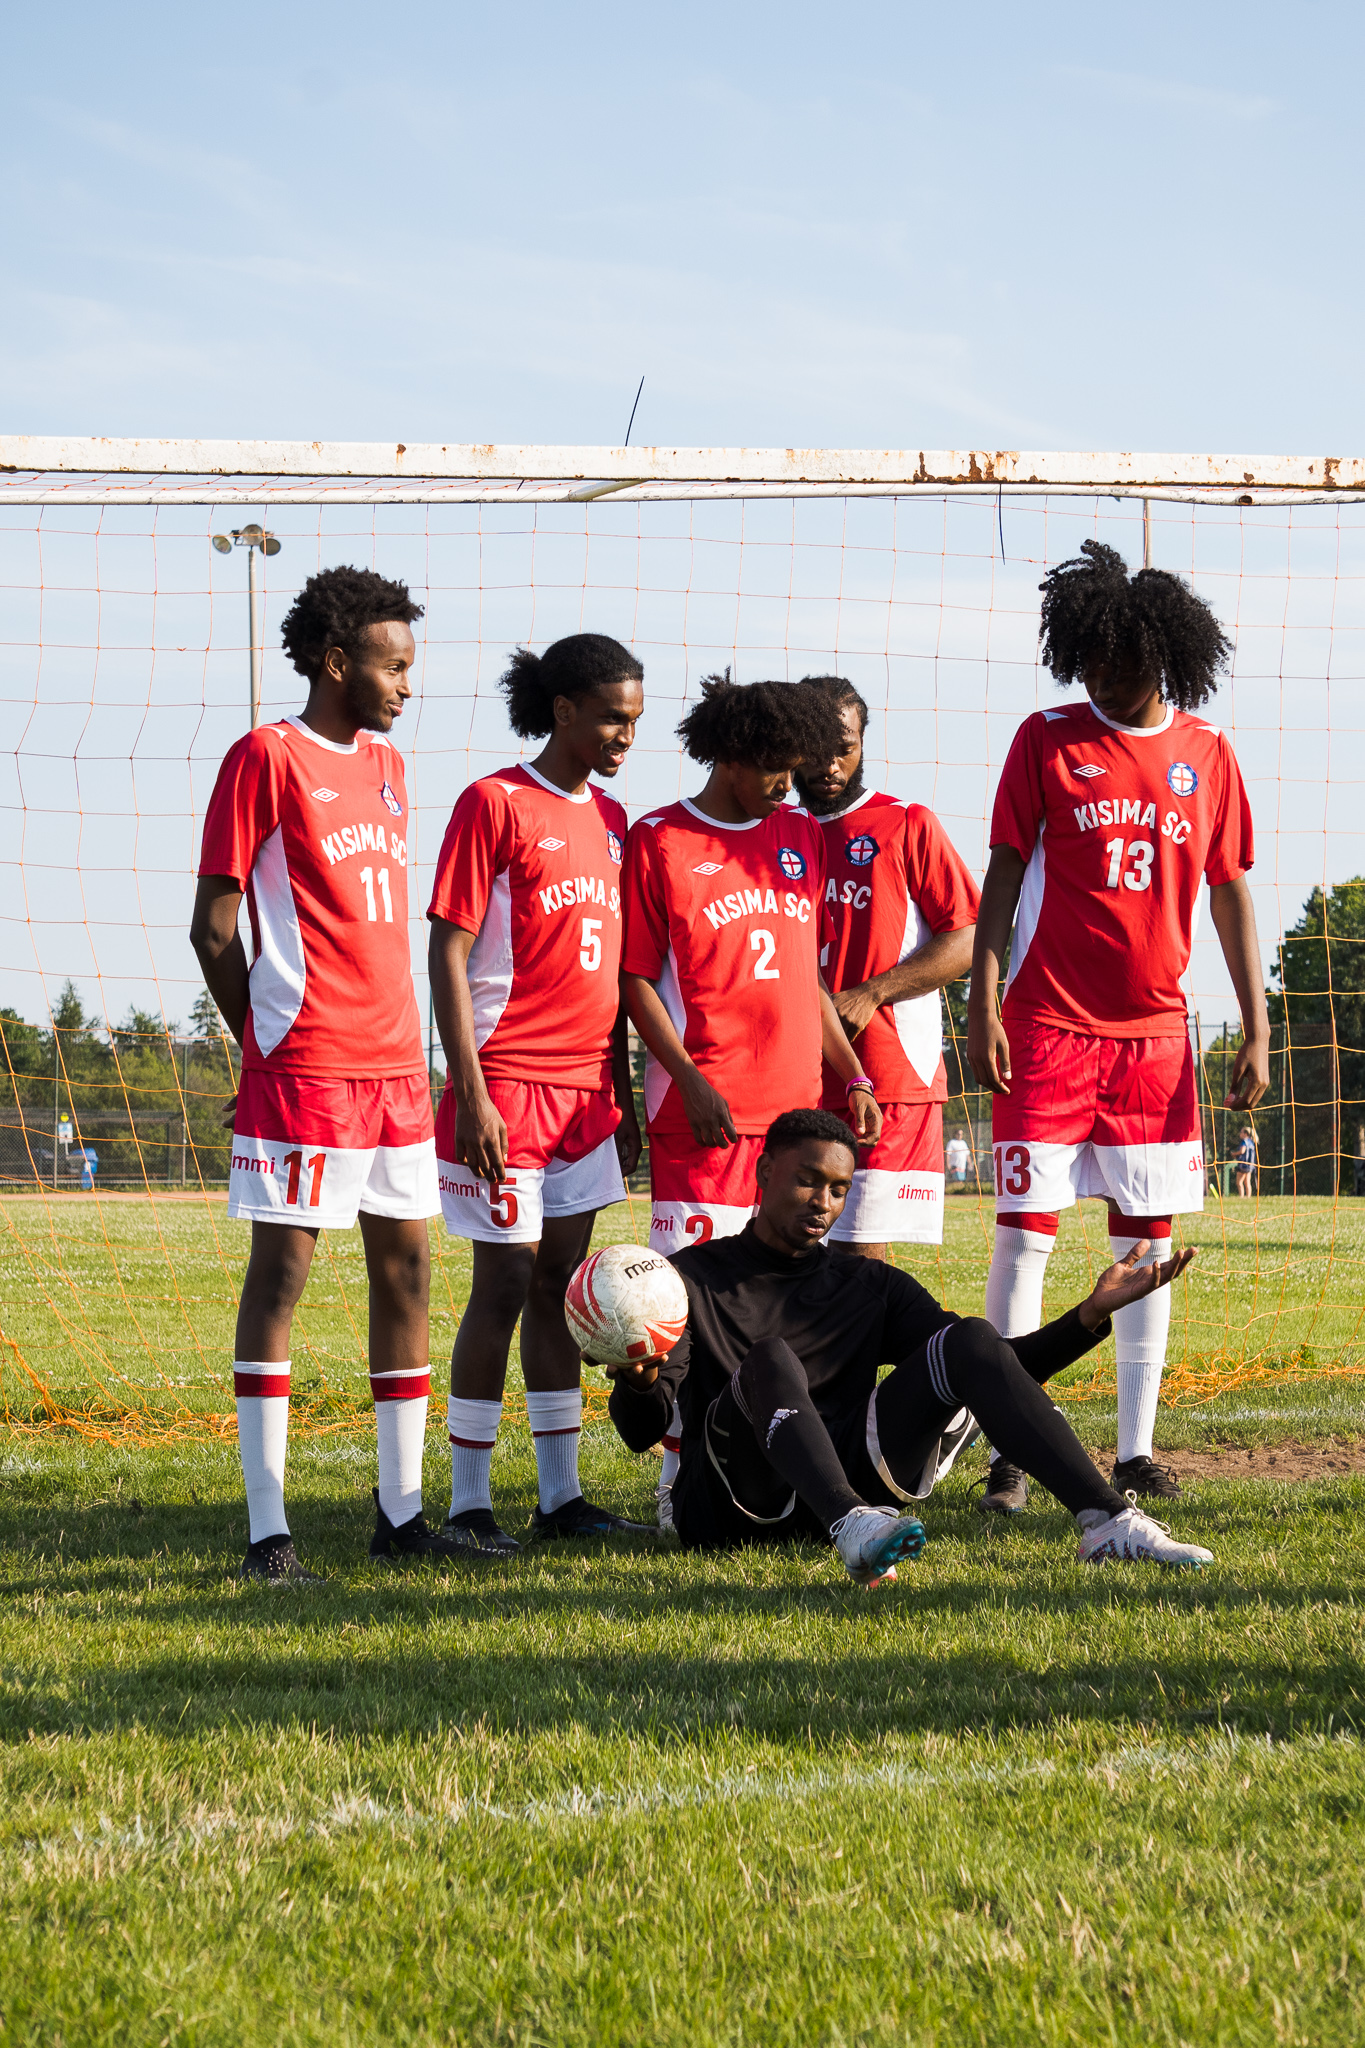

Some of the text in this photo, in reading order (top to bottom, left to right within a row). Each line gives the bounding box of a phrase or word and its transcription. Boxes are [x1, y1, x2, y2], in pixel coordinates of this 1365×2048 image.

[320, 823, 407, 867] KISIMA SC
[1073, 798, 1192, 845] KISIMA SC
[1106, 837, 1155, 891] 13
[360, 866, 394, 923] 11
[538, 876, 621, 920] KISIMA SC
[702, 888, 812, 931] KISIMA SC
[840, 880, 872, 910] SC
[580, 917, 603, 972] 5
[750, 928, 780, 980] 2
[232, 1150, 327, 1207] mmi 11
[897, 1184, 937, 1201] dimmi
[994, 1145, 1031, 1197] 13
[439, 1175, 518, 1228] dimmi 5
[685, 1214, 714, 1246] 2
[624, 1259, 670, 1279] macr
